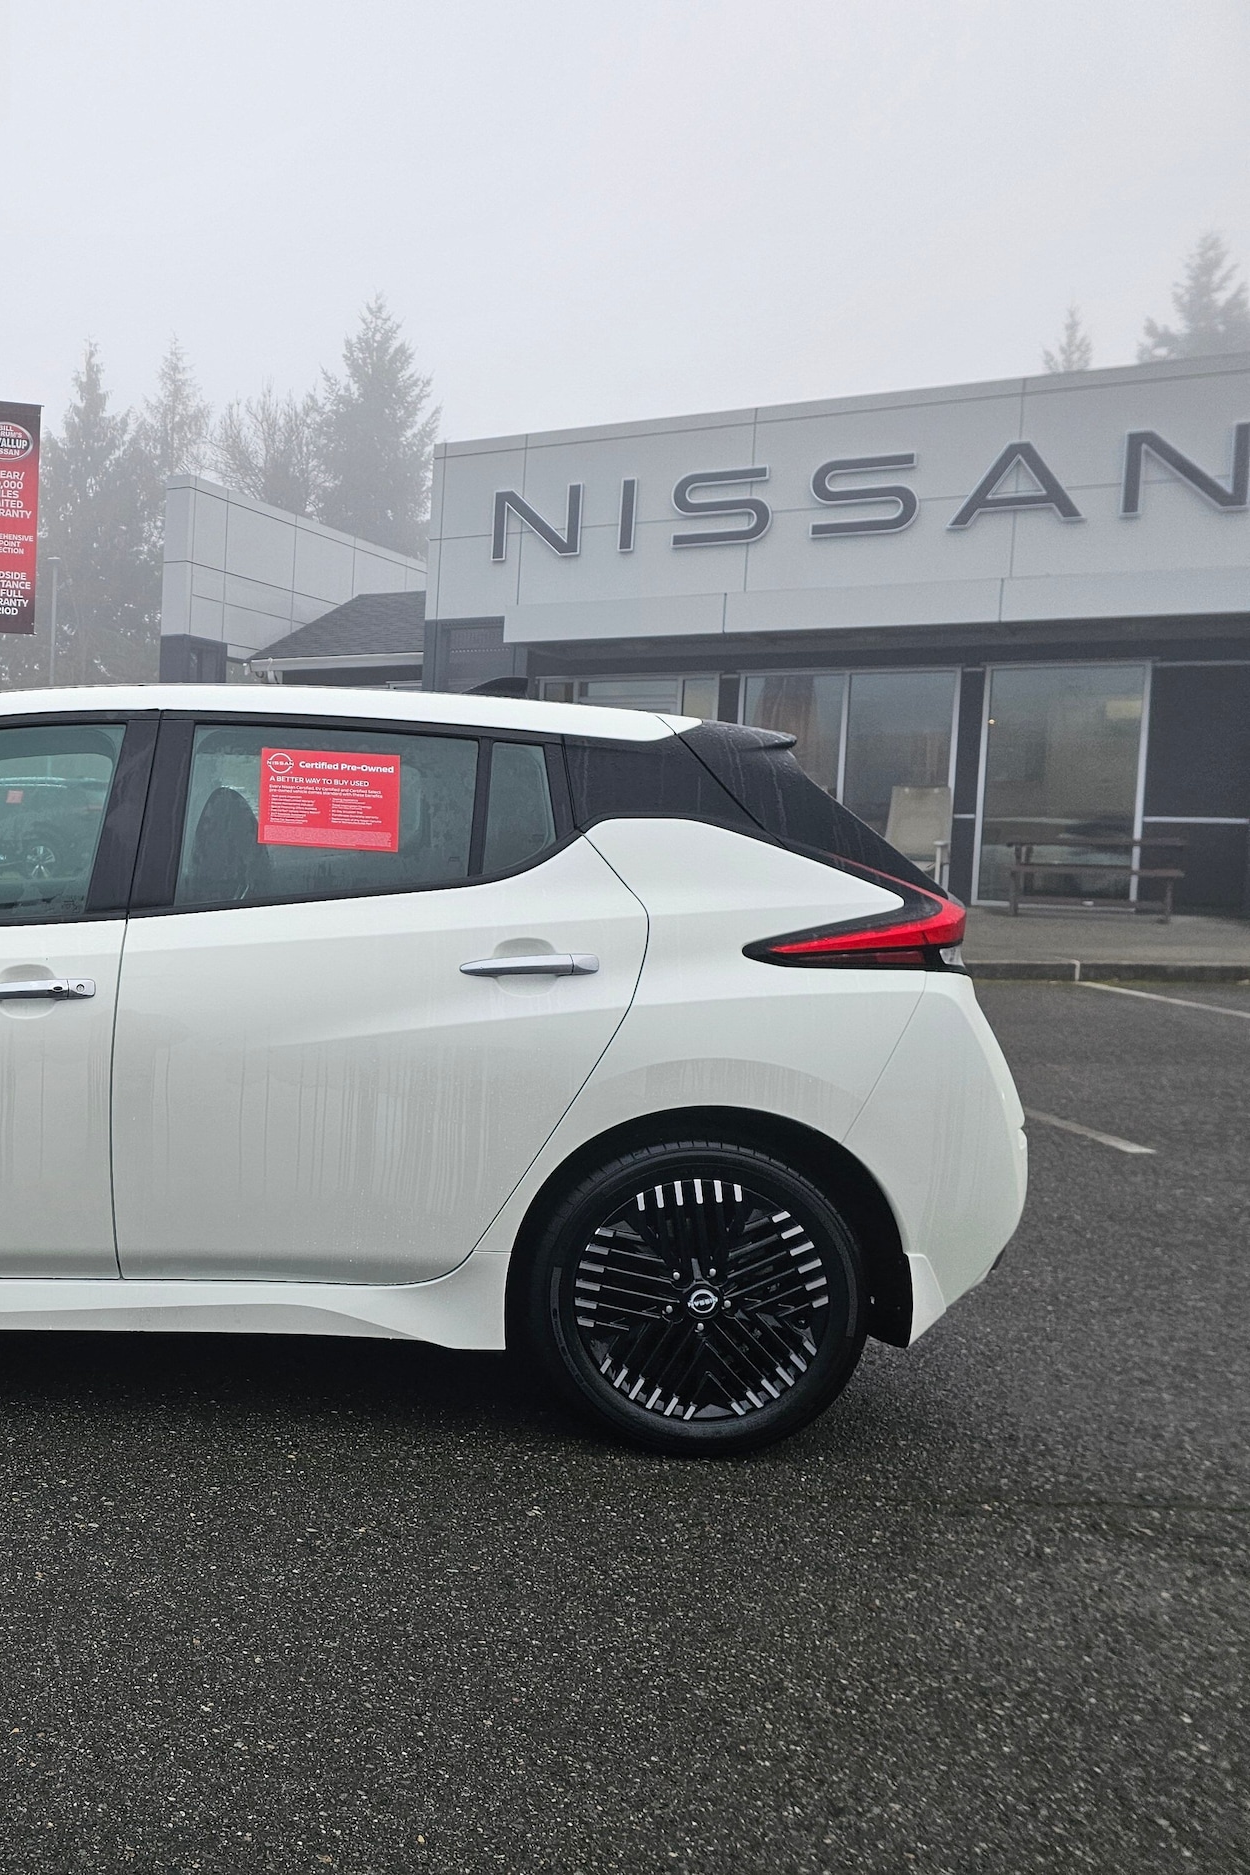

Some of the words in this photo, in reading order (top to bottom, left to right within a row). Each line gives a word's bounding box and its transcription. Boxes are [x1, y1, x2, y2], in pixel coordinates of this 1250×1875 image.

[491, 422, 1250, 562] NISSAN
[0, 589, 23, 598] FULL
[299, 761, 339, 771] Certified
[341, 763, 395, 773] Pre-Owned
[276, 776, 304, 784] BETTER
